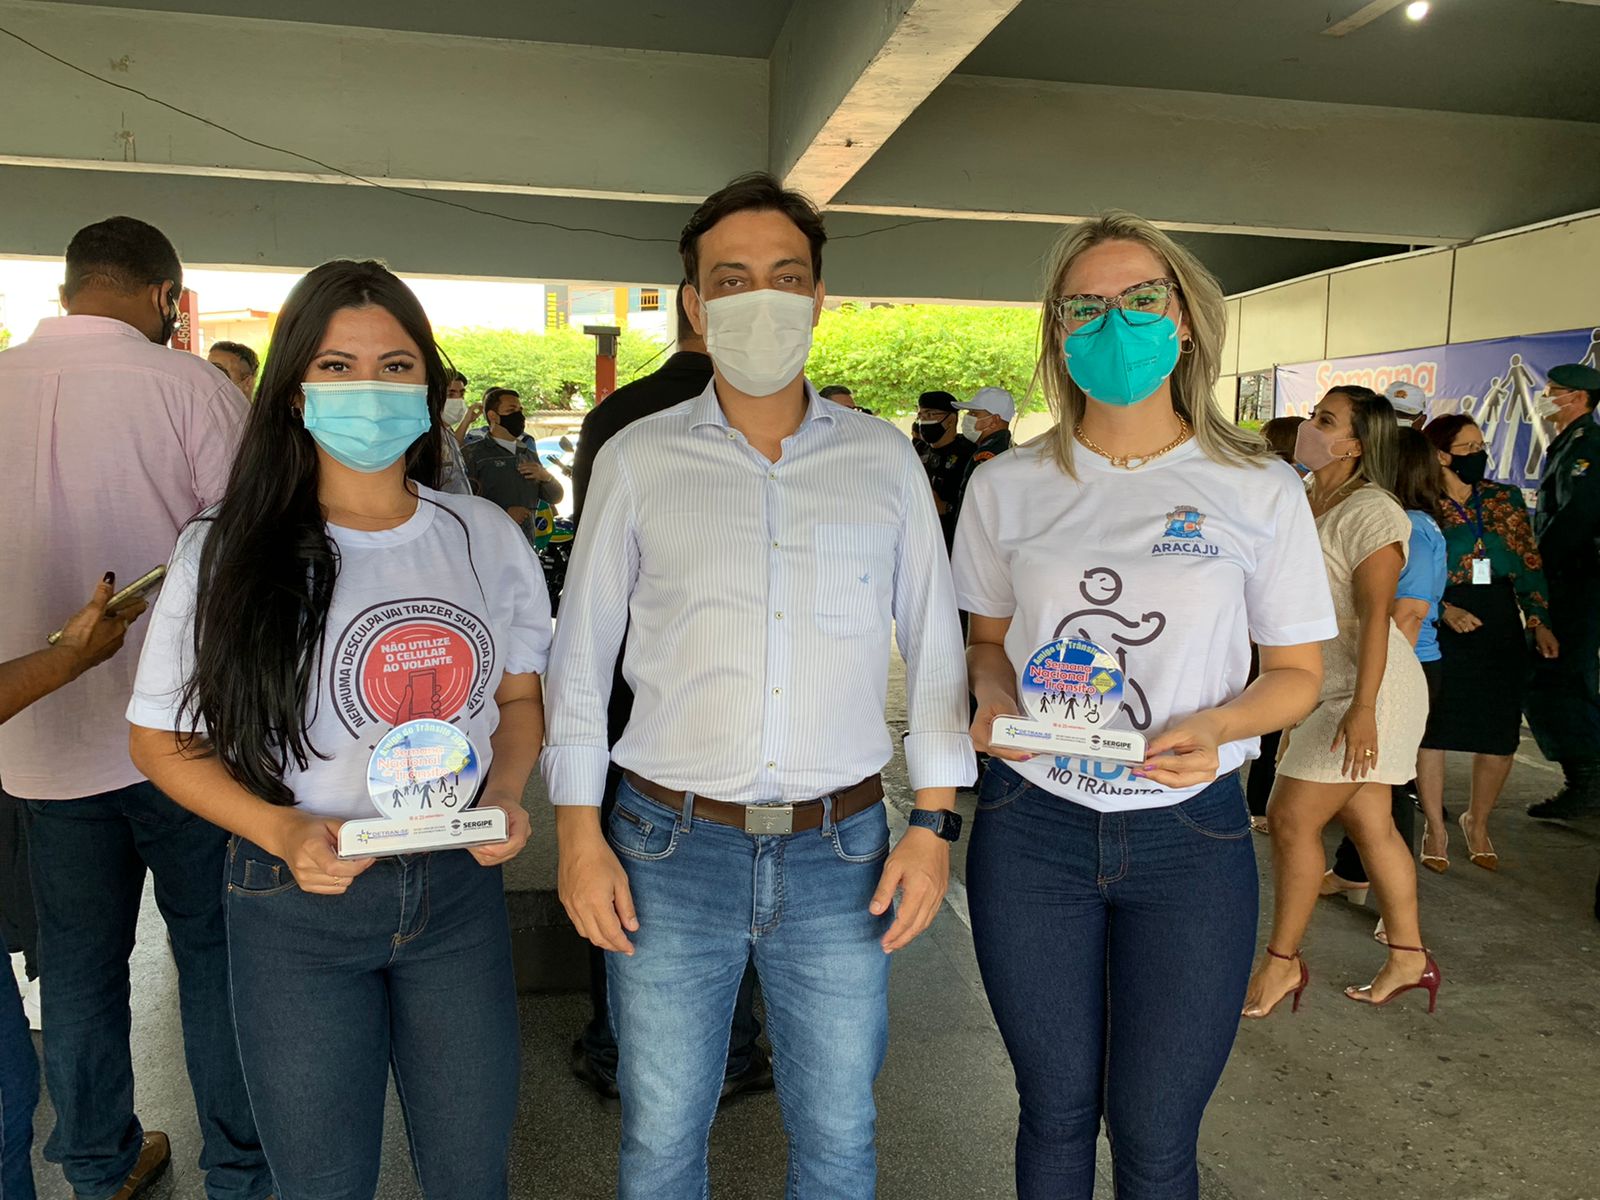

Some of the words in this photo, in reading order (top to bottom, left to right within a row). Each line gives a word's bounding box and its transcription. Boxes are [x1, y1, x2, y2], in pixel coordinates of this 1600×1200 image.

[1152, 543, 1219, 555] ARACAJU
[381, 607, 403, 620] VAI
[403, 604, 453, 619] TRAZER
[453, 613, 477, 633] SUA
[342, 615, 382, 668] DESCULPA
[381, 641, 406, 654] NÃO
[409, 636, 452, 650] UTILIZE
[475, 630, 490, 658] VIDA
[386, 654, 394, 663] O
[396, 647, 447, 661] CELULAR
[383, 663, 400, 673] AO
[401, 655, 453, 671] VOLANTE
[1045, 658, 1093, 674] Semana
[1030, 665, 1090, 683] Nacional
[1044, 678, 1098, 696] Trânsito
[339, 669, 366, 728] NENHUMA
[394, 747, 444, 757] Semana
[1102, 740, 1132, 749] SERGIPE
[377, 753, 442, 770] Nacional
[1047, 766, 1072, 784] NO
[463, 819, 493, 829] SERGIPE
